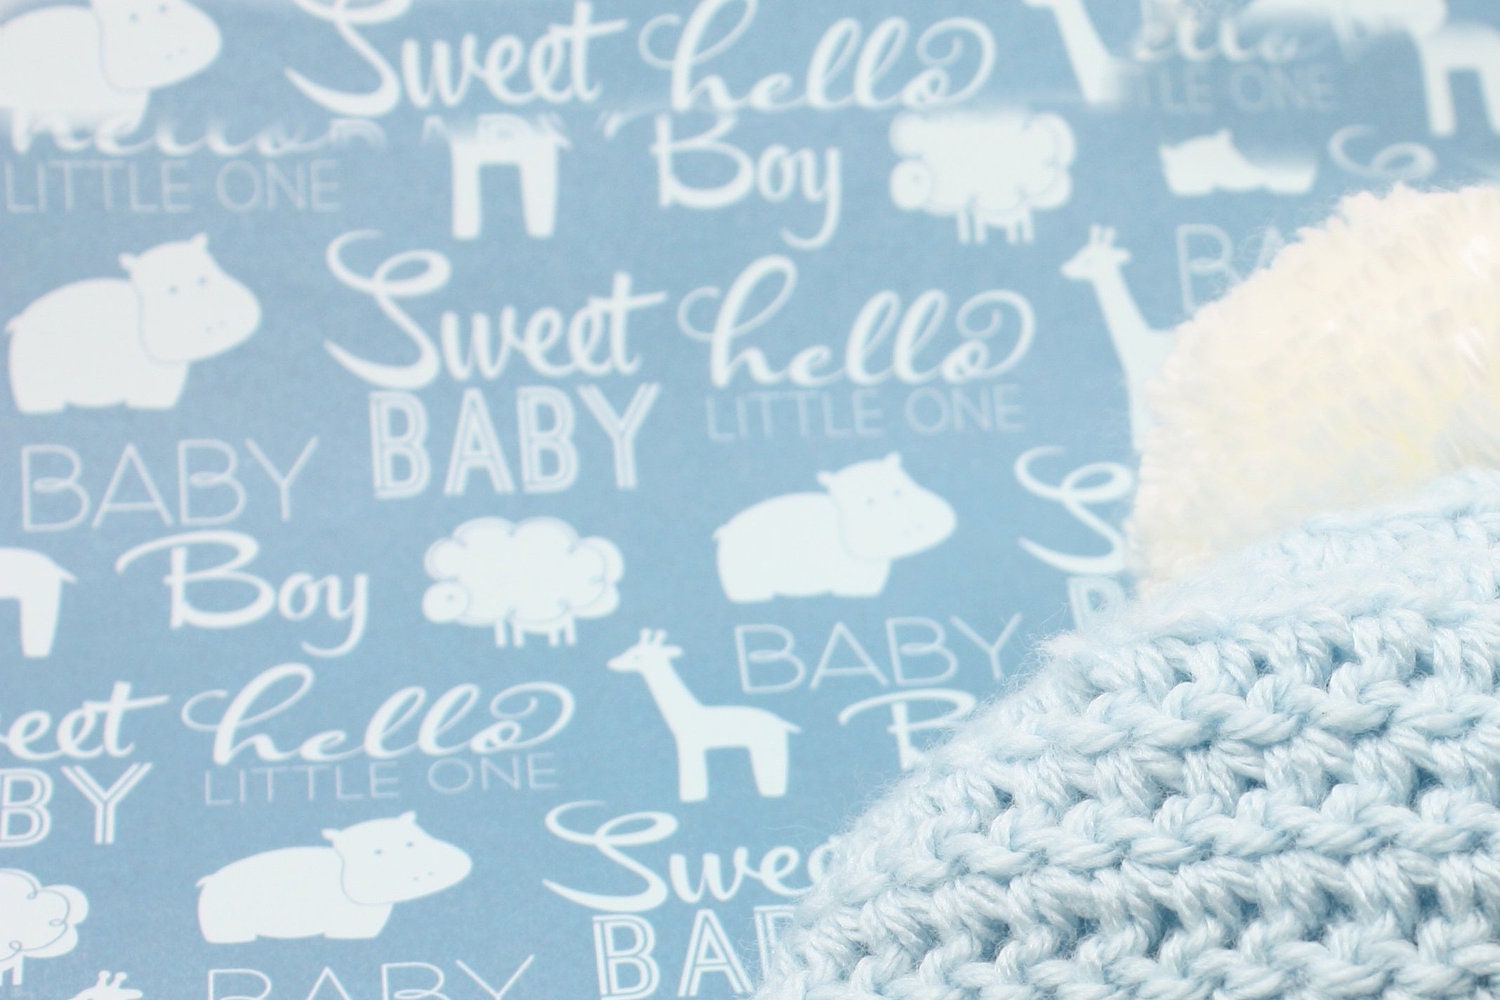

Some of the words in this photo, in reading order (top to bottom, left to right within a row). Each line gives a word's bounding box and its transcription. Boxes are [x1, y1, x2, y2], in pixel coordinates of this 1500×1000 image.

[285, 0, 628, 118] Sweet
[638, 0, 996, 113] hello
[4, 158, 192, 214] LITTLE
[216, 158, 342, 214] ONE
[603, 102, 842, 250] Boy
[324, 228, 669, 390] Sweet
[676, 254, 1036, 388] hello
[368, 382, 662, 499] BABY
[703, 387, 885, 443] LITTLE
[903, 382, 1028, 436] ONE
[20, 436, 319, 533] BABY
[114, 529, 368, 658] Boy
[733, 612, 1023, 695] BABY
[180, 662, 576, 766] hello
[204, 757, 401, 807] LITTLE
[427, 750, 560, 793] ONE
[541, 798, 838, 914] Swee
